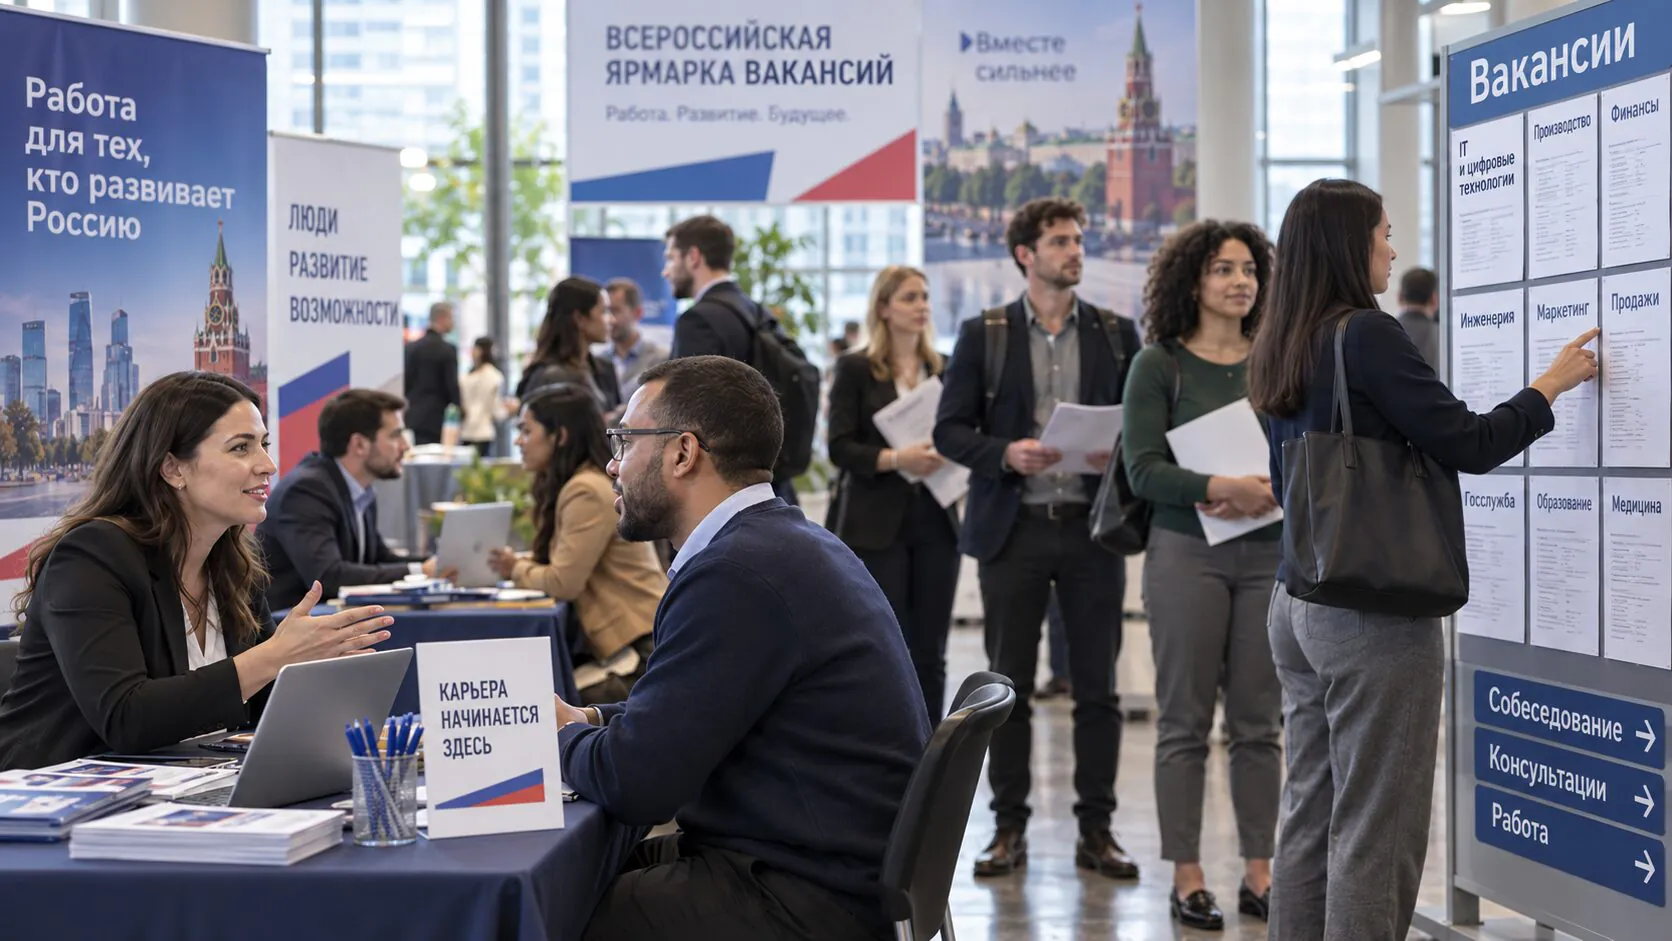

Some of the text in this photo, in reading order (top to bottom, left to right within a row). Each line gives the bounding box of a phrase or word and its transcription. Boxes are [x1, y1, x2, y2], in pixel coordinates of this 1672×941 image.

[606, 21, 832, 51] ВСЕРОССИЙСКАЯ
[977, 31, 1066, 54] Вместе
[606, 54, 894, 85] ЯРМАРКА ВАКАНСИЙ
[975, 64, 1077, 82] сильнее
[1471, 22, 1635, 104] Вакансии
[25, 76, 137, 121] Работа
[1611, 98, 1659, 124] Финансы
[606, 105, 851, 125] Работа. Развитие. Будущее.
[1534, 114, 1591, 143] Производство
[25, 126, 150, 168] для тех,
[1459, 140, 1468, 158] IT
[1459, 153, 1515, 177] и цифровые
[27, 167, 235, 210] кто развивает
[1459, 173, 1515, 196] технологии
[27, 200, 141, 240] Россию
[288, 203, 338, 238] ЛЮДИ
[289, 250, 368, 282] РАЗВИТИЕ
[290, 296, 399, 327] ВОЗМОЖНОСТИ
[1537, 302, 1589, 323] Маркетинг
[1611, 291, 1660, 314] Продажи
[1460, 310, 1515, 329] Инженерия
[1464, 491, 1515, 511] Госслужба
[1536, 493, 1592, 513] Образование
[1612, 495, 1662, 516] Медицина
[439, 679, 508, 701] КАРЬЕРА
[441, 705, 539, 729] НАЧИНАЕТСЯ
[1488, 686, 1623, 742] Собеседование
[443, 736, 492, 760] ЗДЕСЬ
[1490, 743, 1607, 802] Консультации
[1492, 802, 1549, 845] Работа
